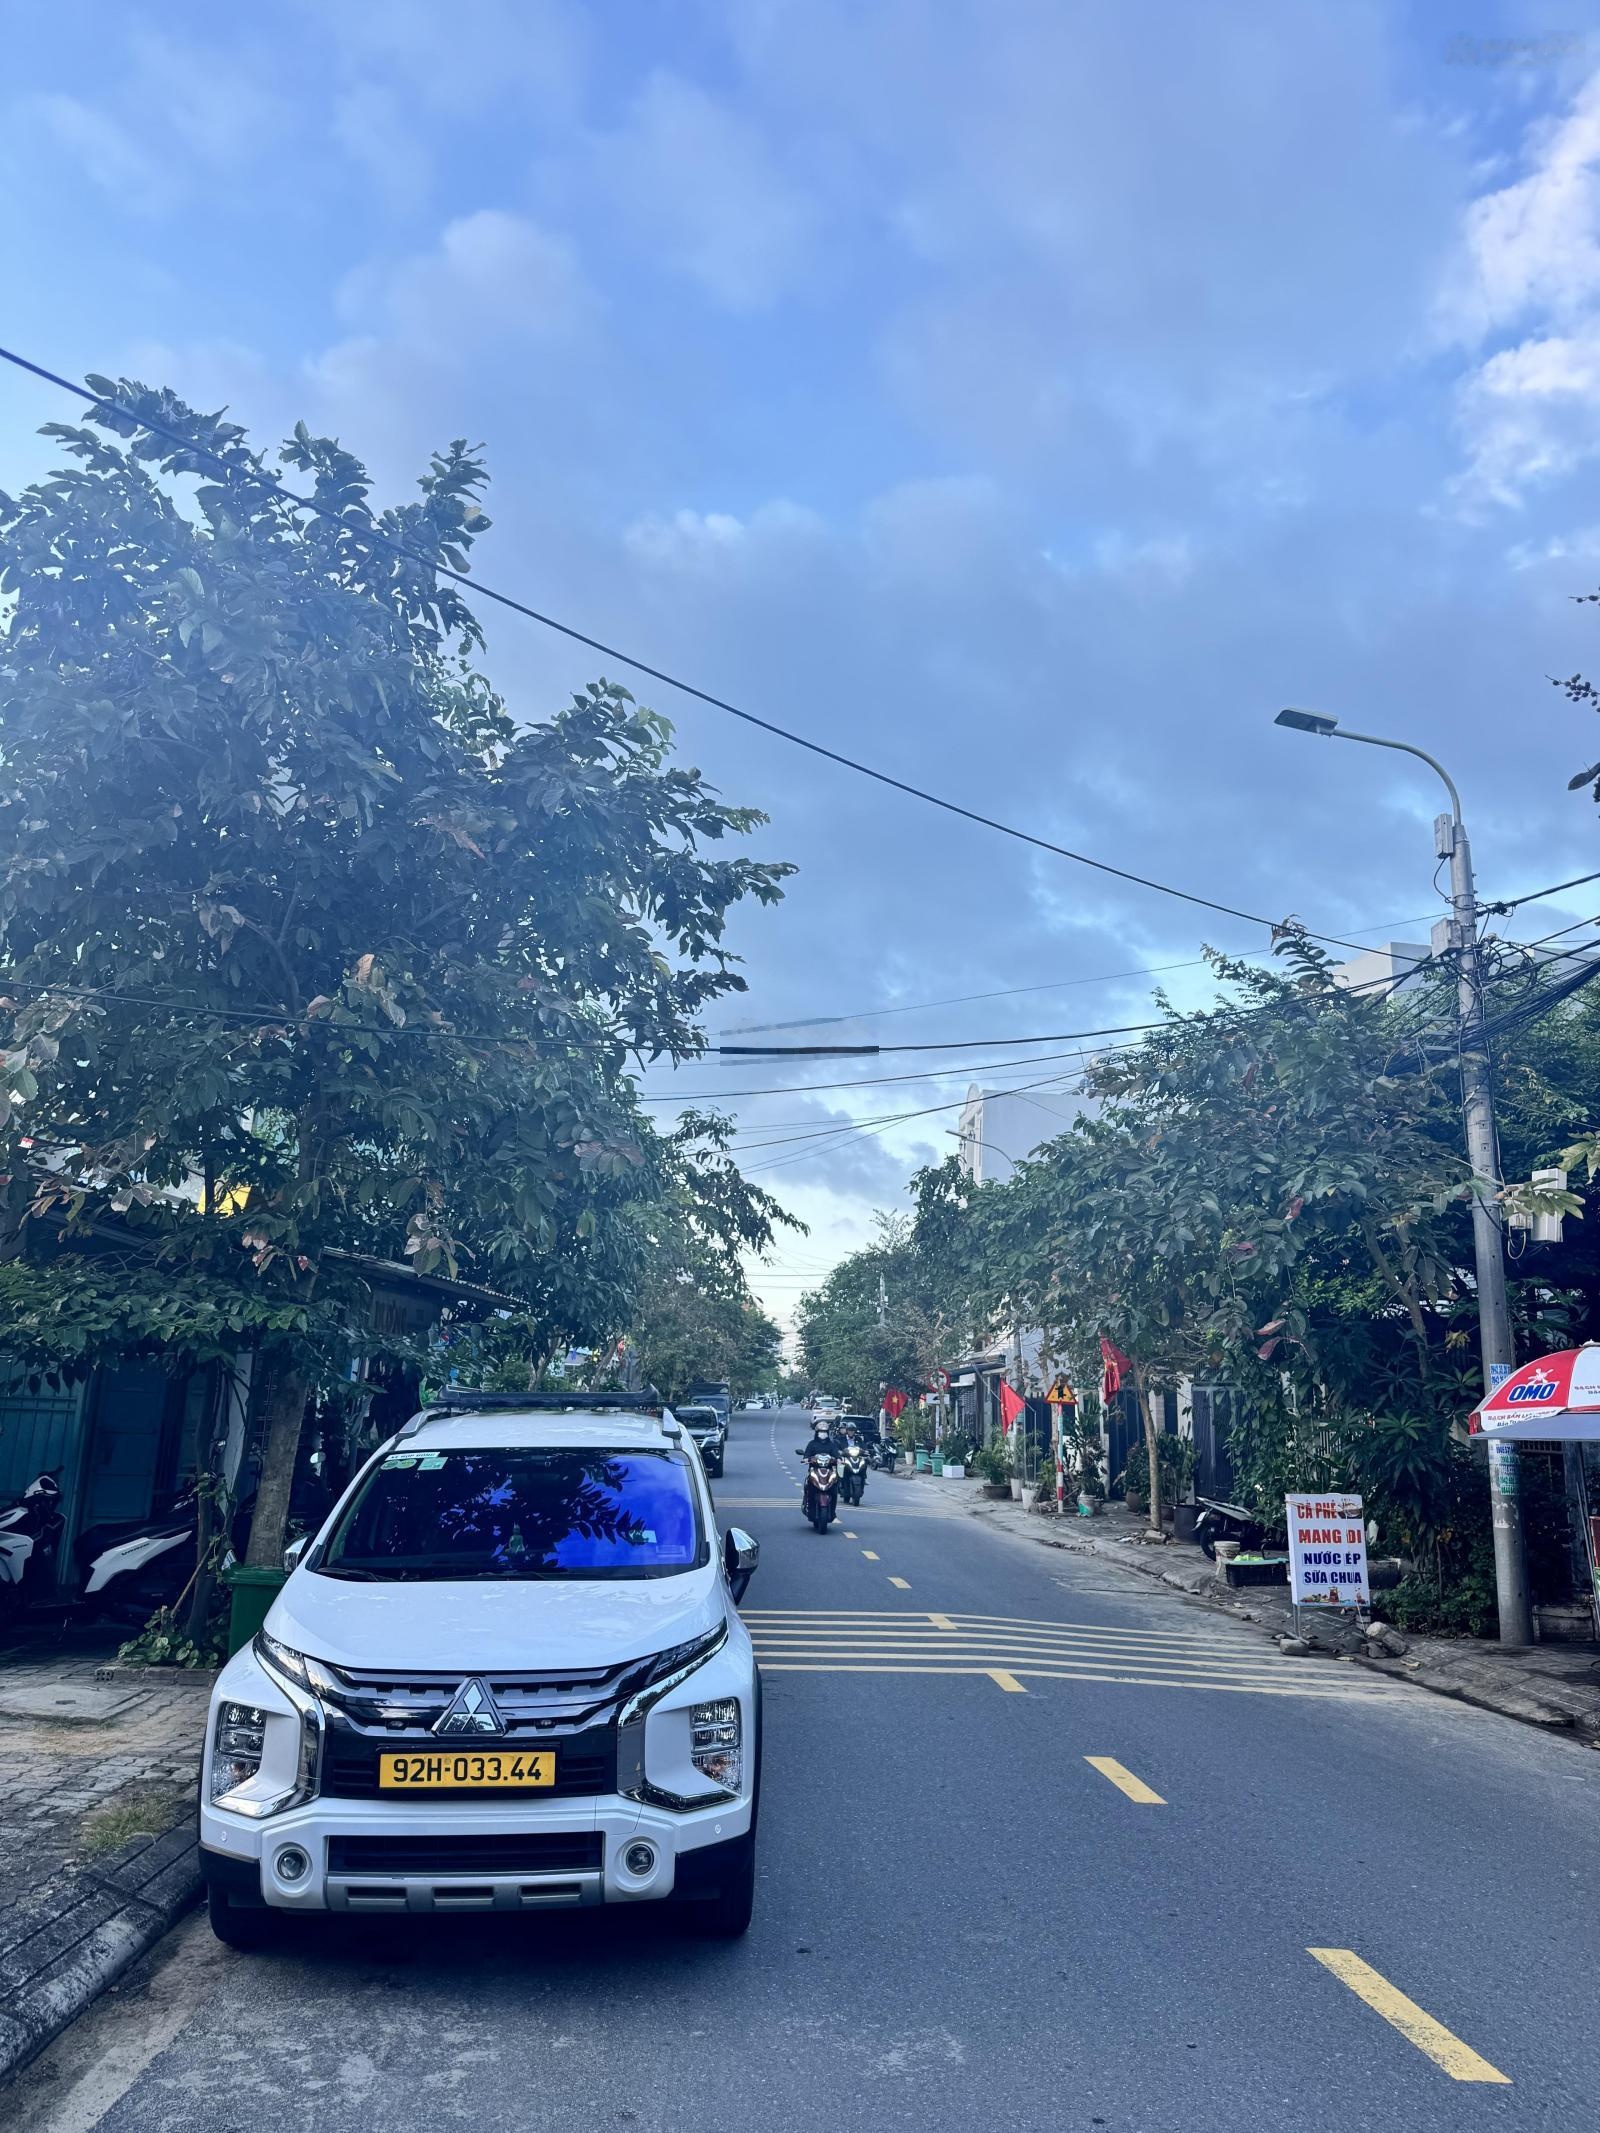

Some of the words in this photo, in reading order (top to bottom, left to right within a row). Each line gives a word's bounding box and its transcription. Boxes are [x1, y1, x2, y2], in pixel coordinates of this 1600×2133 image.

[1508, 1382, 1556, 1402] OMO
[1298, 1529, 1342, 1544] MANG
[1303, 1551, 1341, 1565] NƯỚC
[1345, 1551, 1361, 1565] ÉP
[1304, 1569, 1328, 1584] SỮA
[1330, 1571, 1362, 1584] CHUA
[393, 1756, 542, 1782] 92H-033.44
